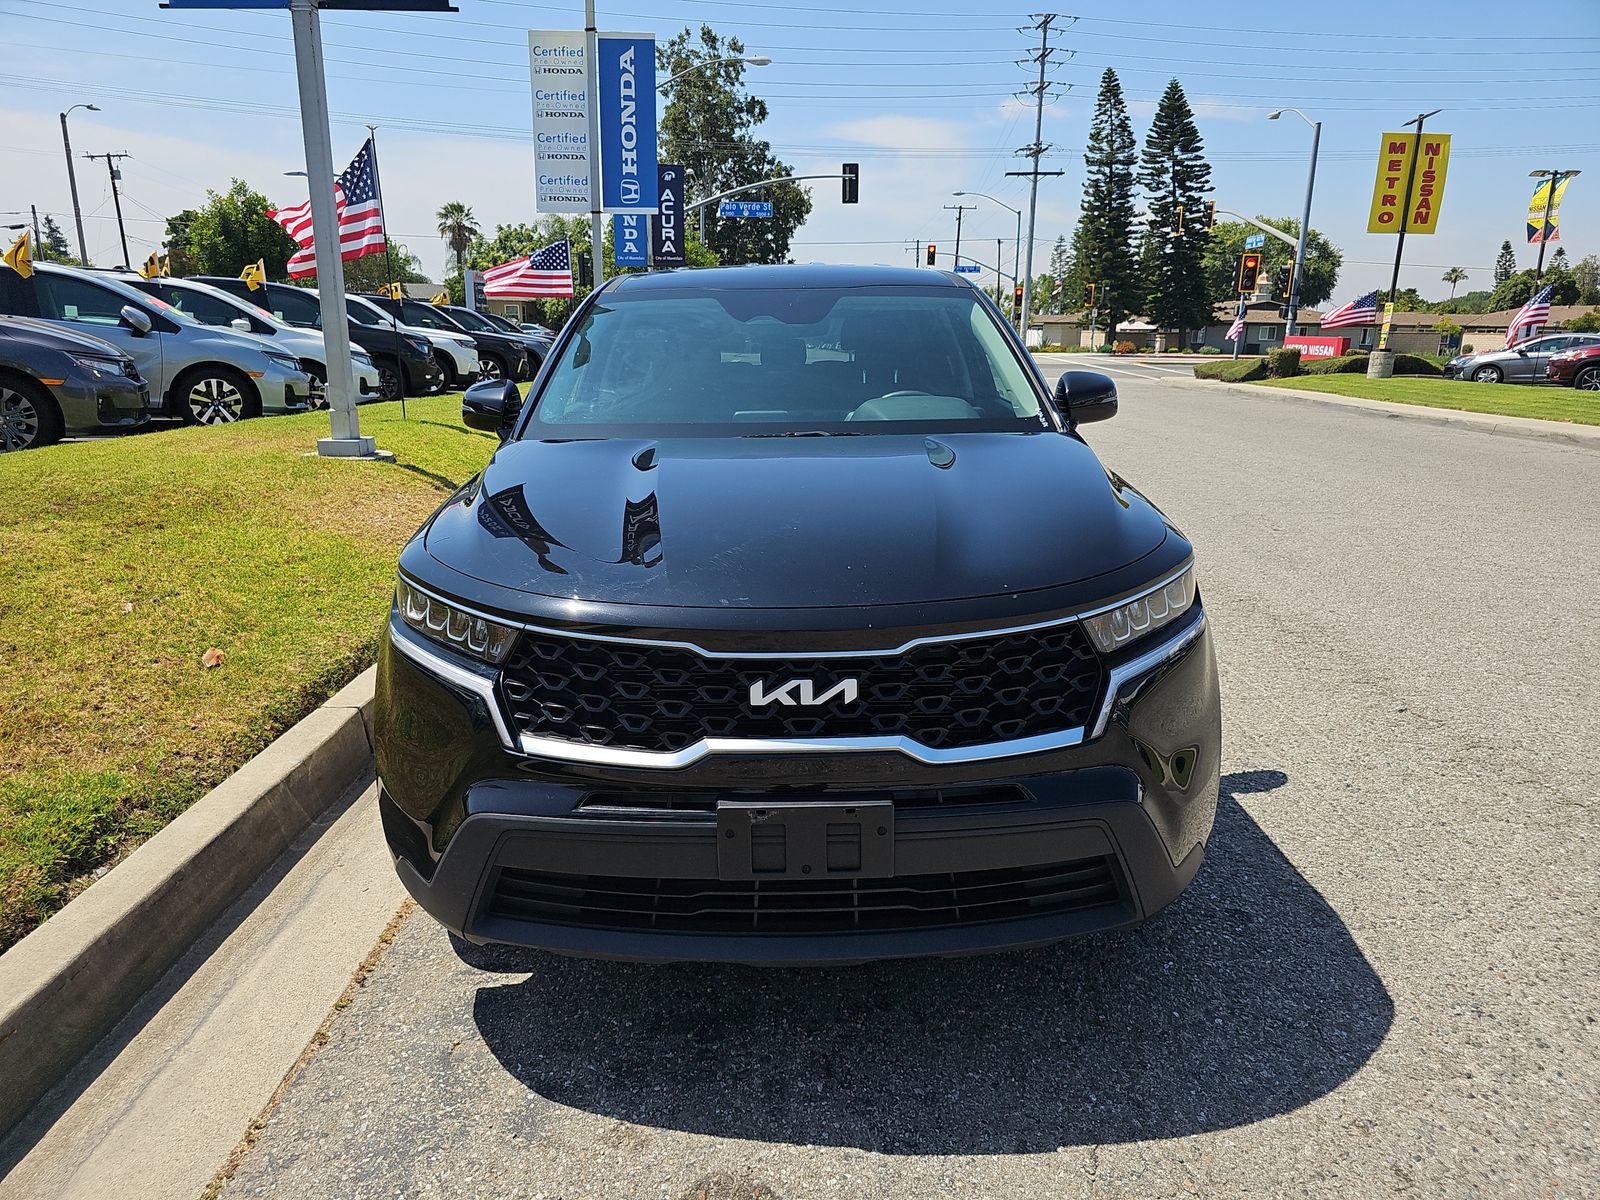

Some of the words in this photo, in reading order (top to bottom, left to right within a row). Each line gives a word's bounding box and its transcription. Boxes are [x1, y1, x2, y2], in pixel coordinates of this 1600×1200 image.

[533, 45, 584, 57] Certified
[543, 67, 584, 75] HONDA
[535, 89, 585, 101] Certified
[619, 45, 638, 176] HONDA
[537, 132, 586, 144] Certified
[539, 174, 588, 186] Certified
[1378, 142, 1407, 224] METRO
[1413, 143, 1441, 225] NISSAN
[540, 186, 588, 194] Pre-Owned
[660, 188, 676, 253] ACURA
[622, 215, 639, 253] NDA
[1308, 345, 1334, 356] NISSAN
[750, 678, 858, 706] KIA
